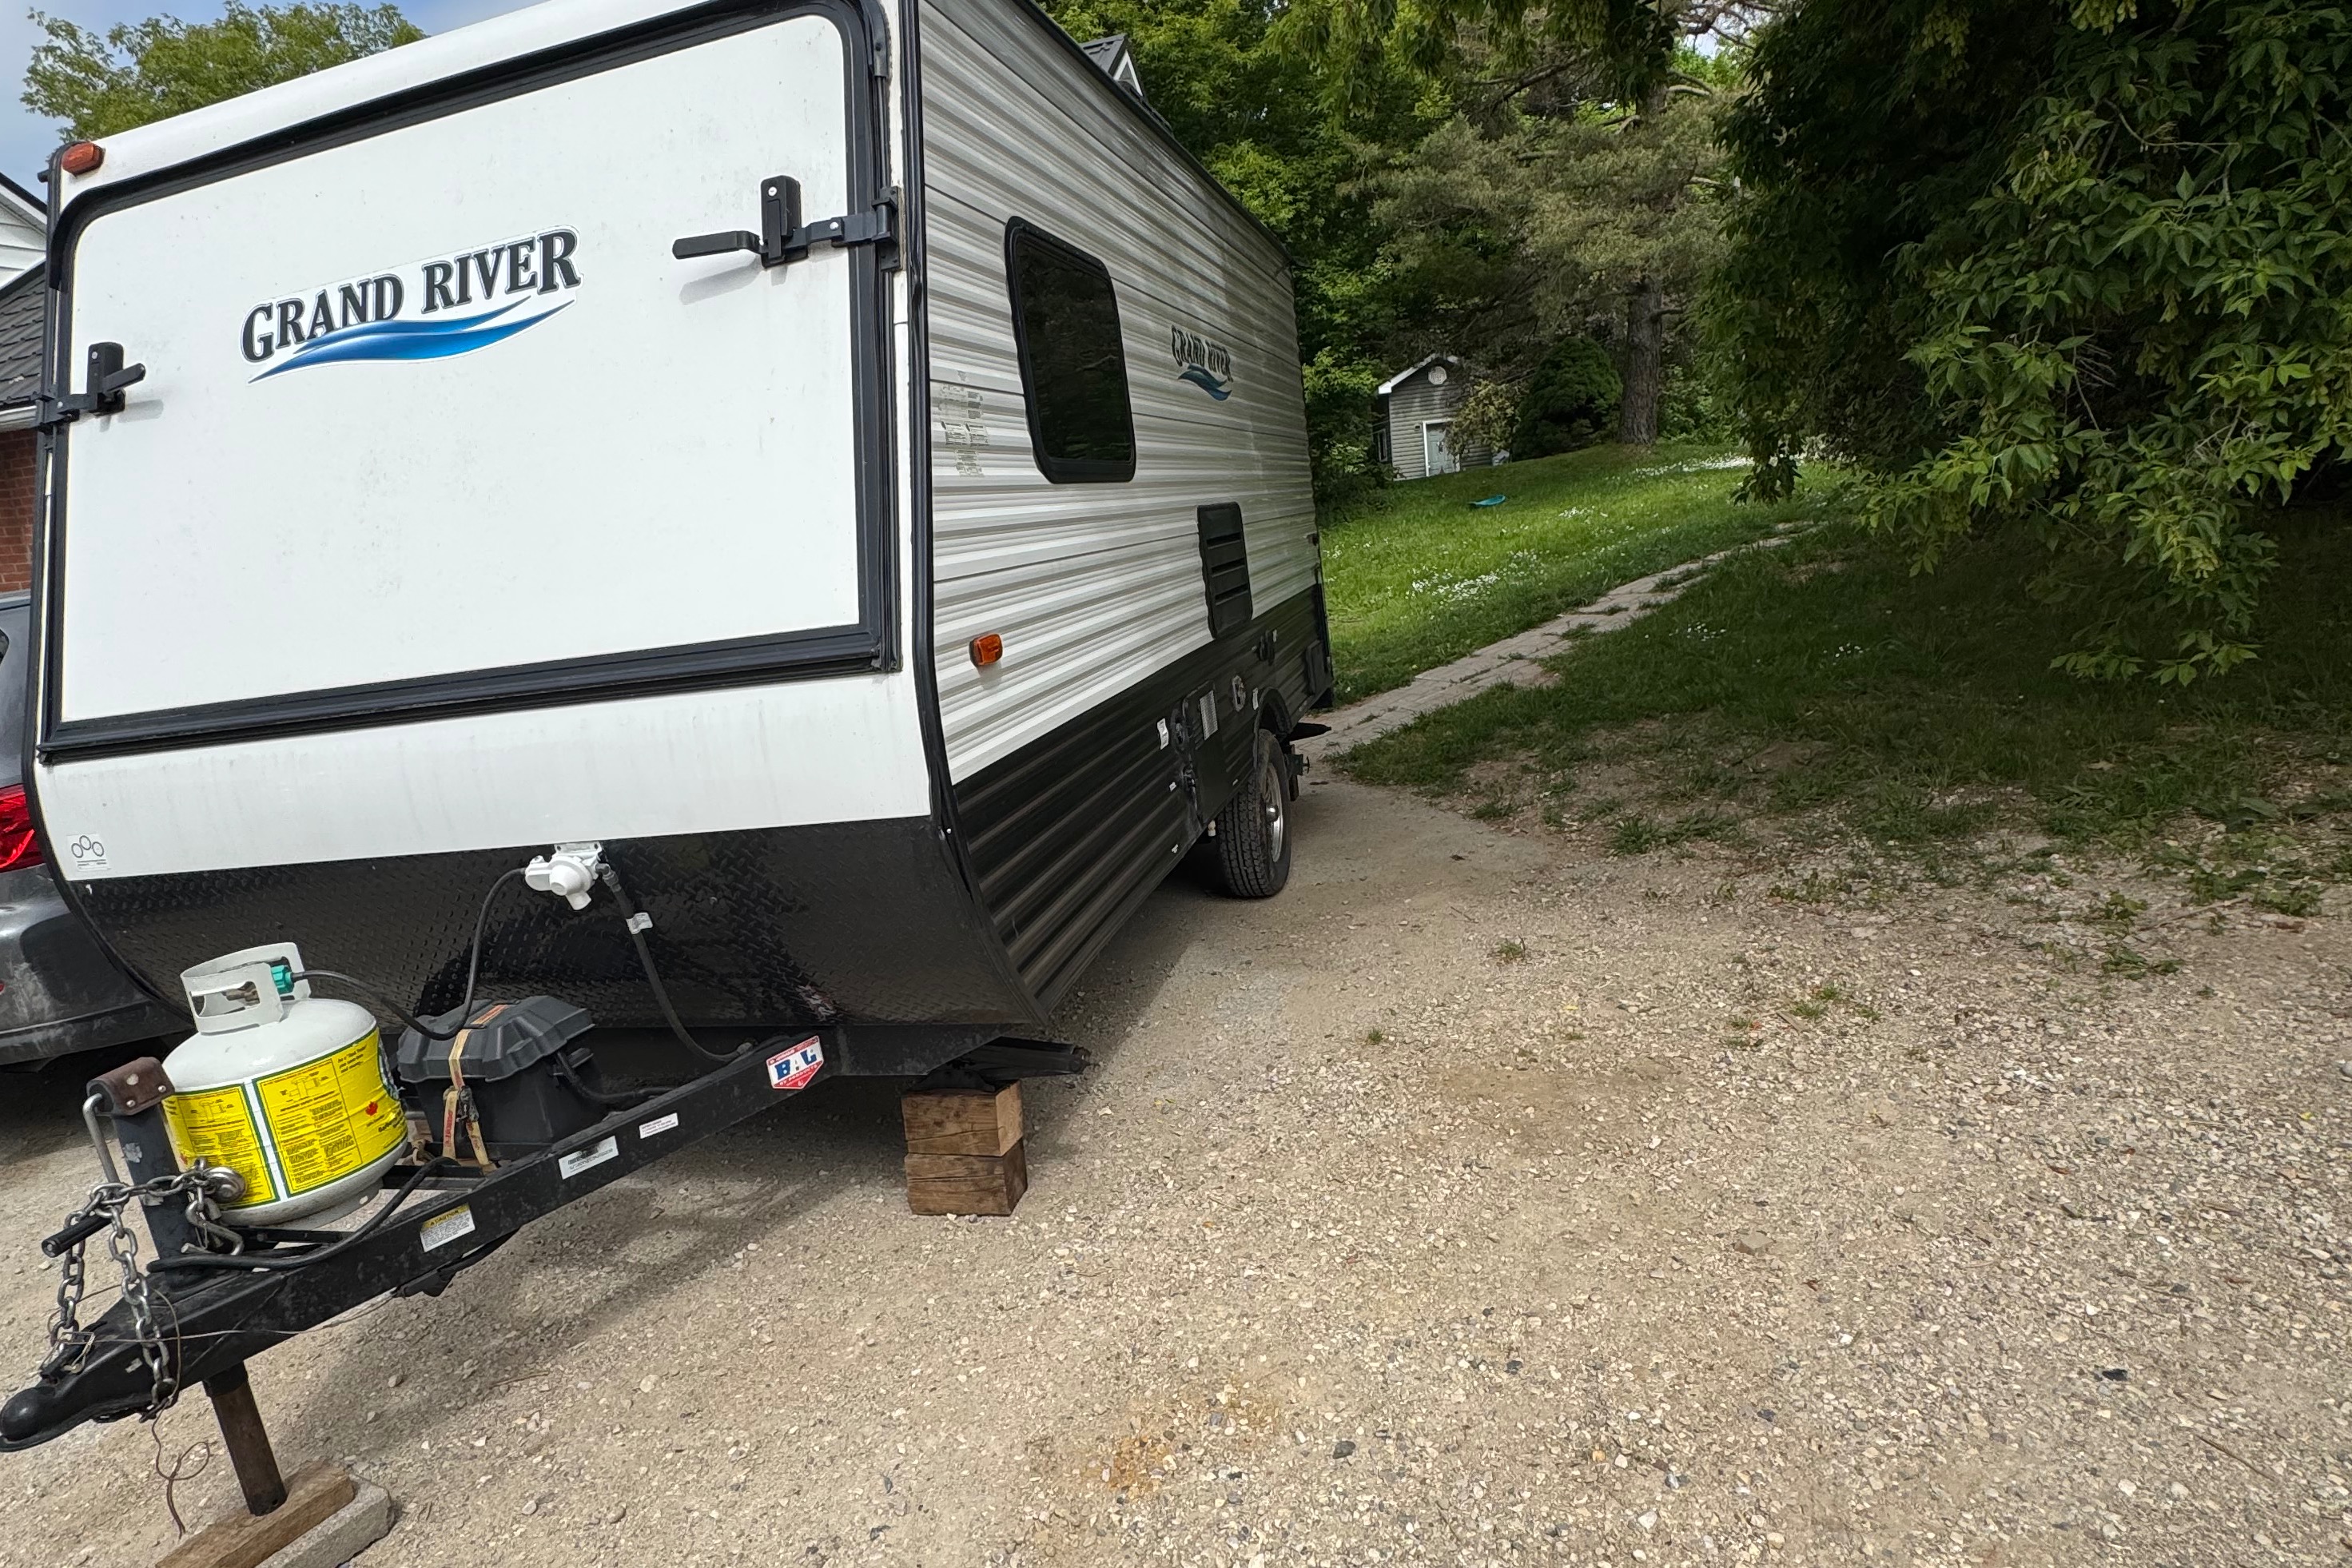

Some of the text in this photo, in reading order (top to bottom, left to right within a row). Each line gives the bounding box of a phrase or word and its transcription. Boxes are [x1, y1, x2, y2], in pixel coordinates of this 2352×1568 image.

[241, 228, 583, 362] GRAND RIVER
[1172, 325, 1233, 383] GRAND RIVER
